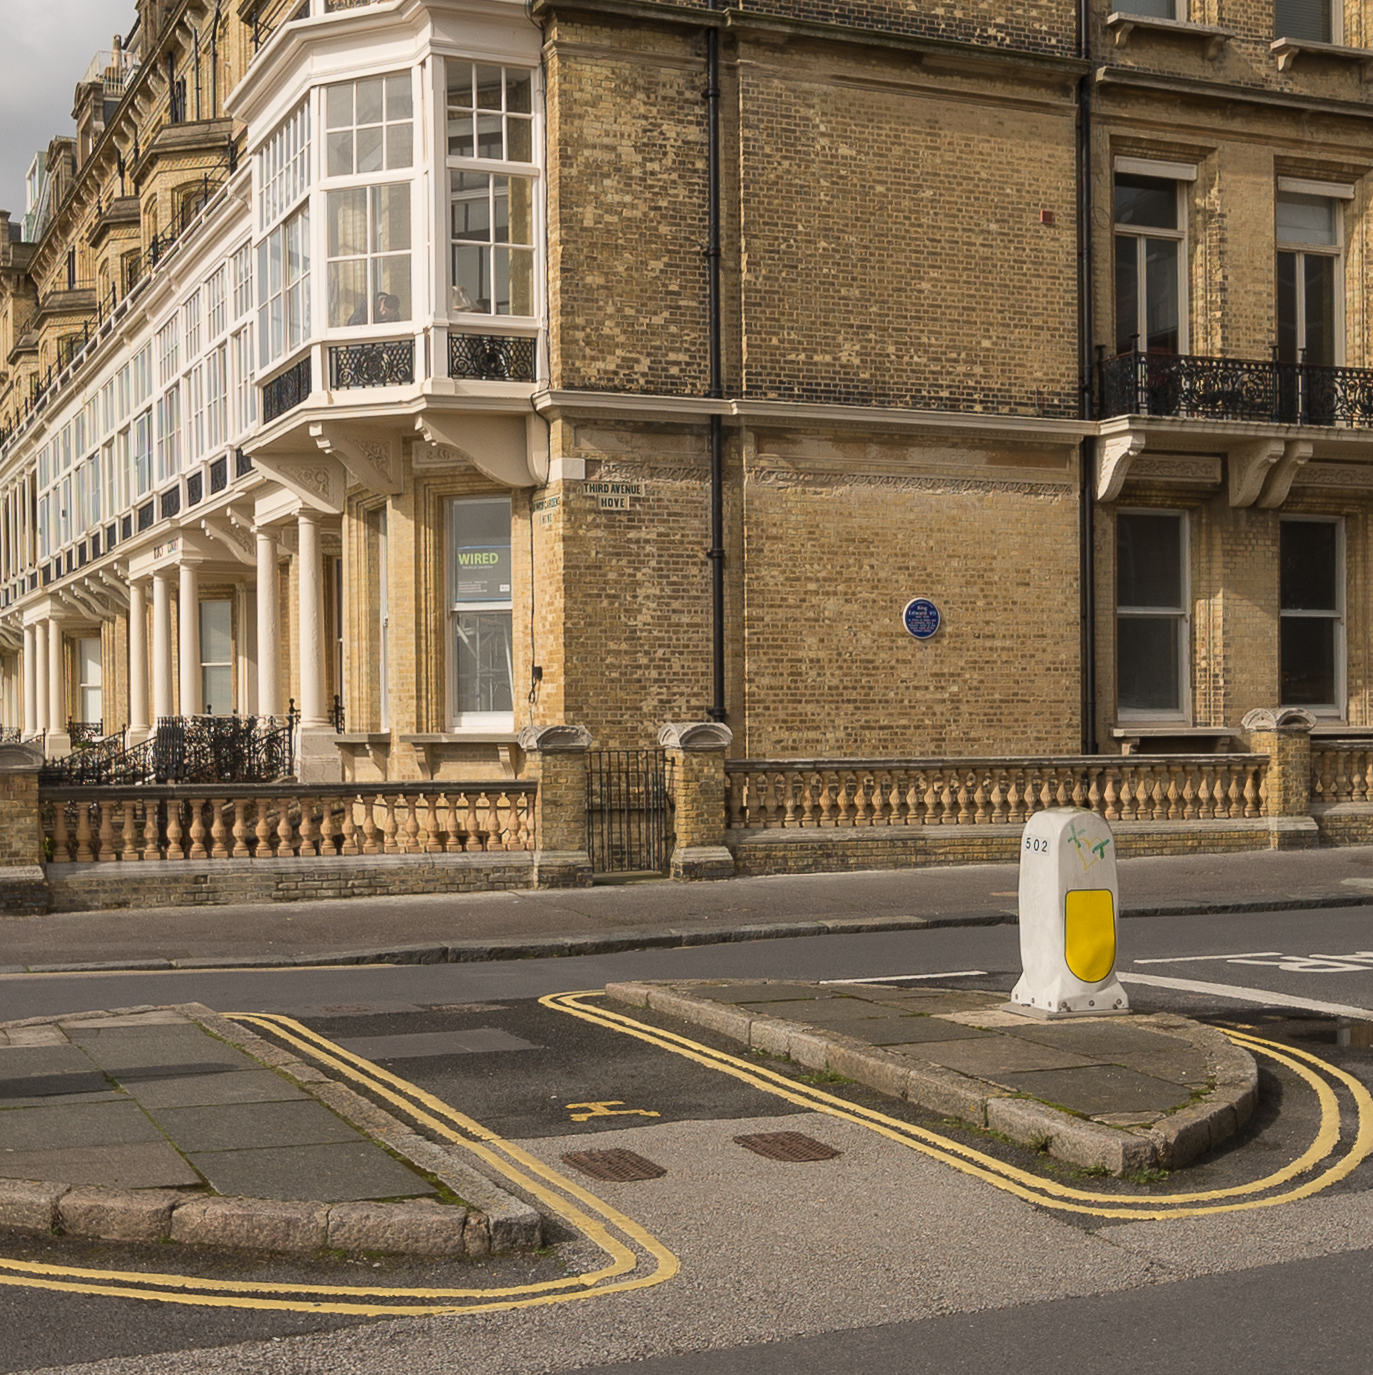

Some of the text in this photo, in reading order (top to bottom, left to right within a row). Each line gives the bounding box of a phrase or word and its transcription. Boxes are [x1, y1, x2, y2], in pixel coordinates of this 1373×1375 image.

[584, 483, 641, 494] THIRD AVENUE
[601, 498, 625, 507] HOVE
[458, 552, 499, 565] WIRED
[1025, 837, 1048, 852] 502
